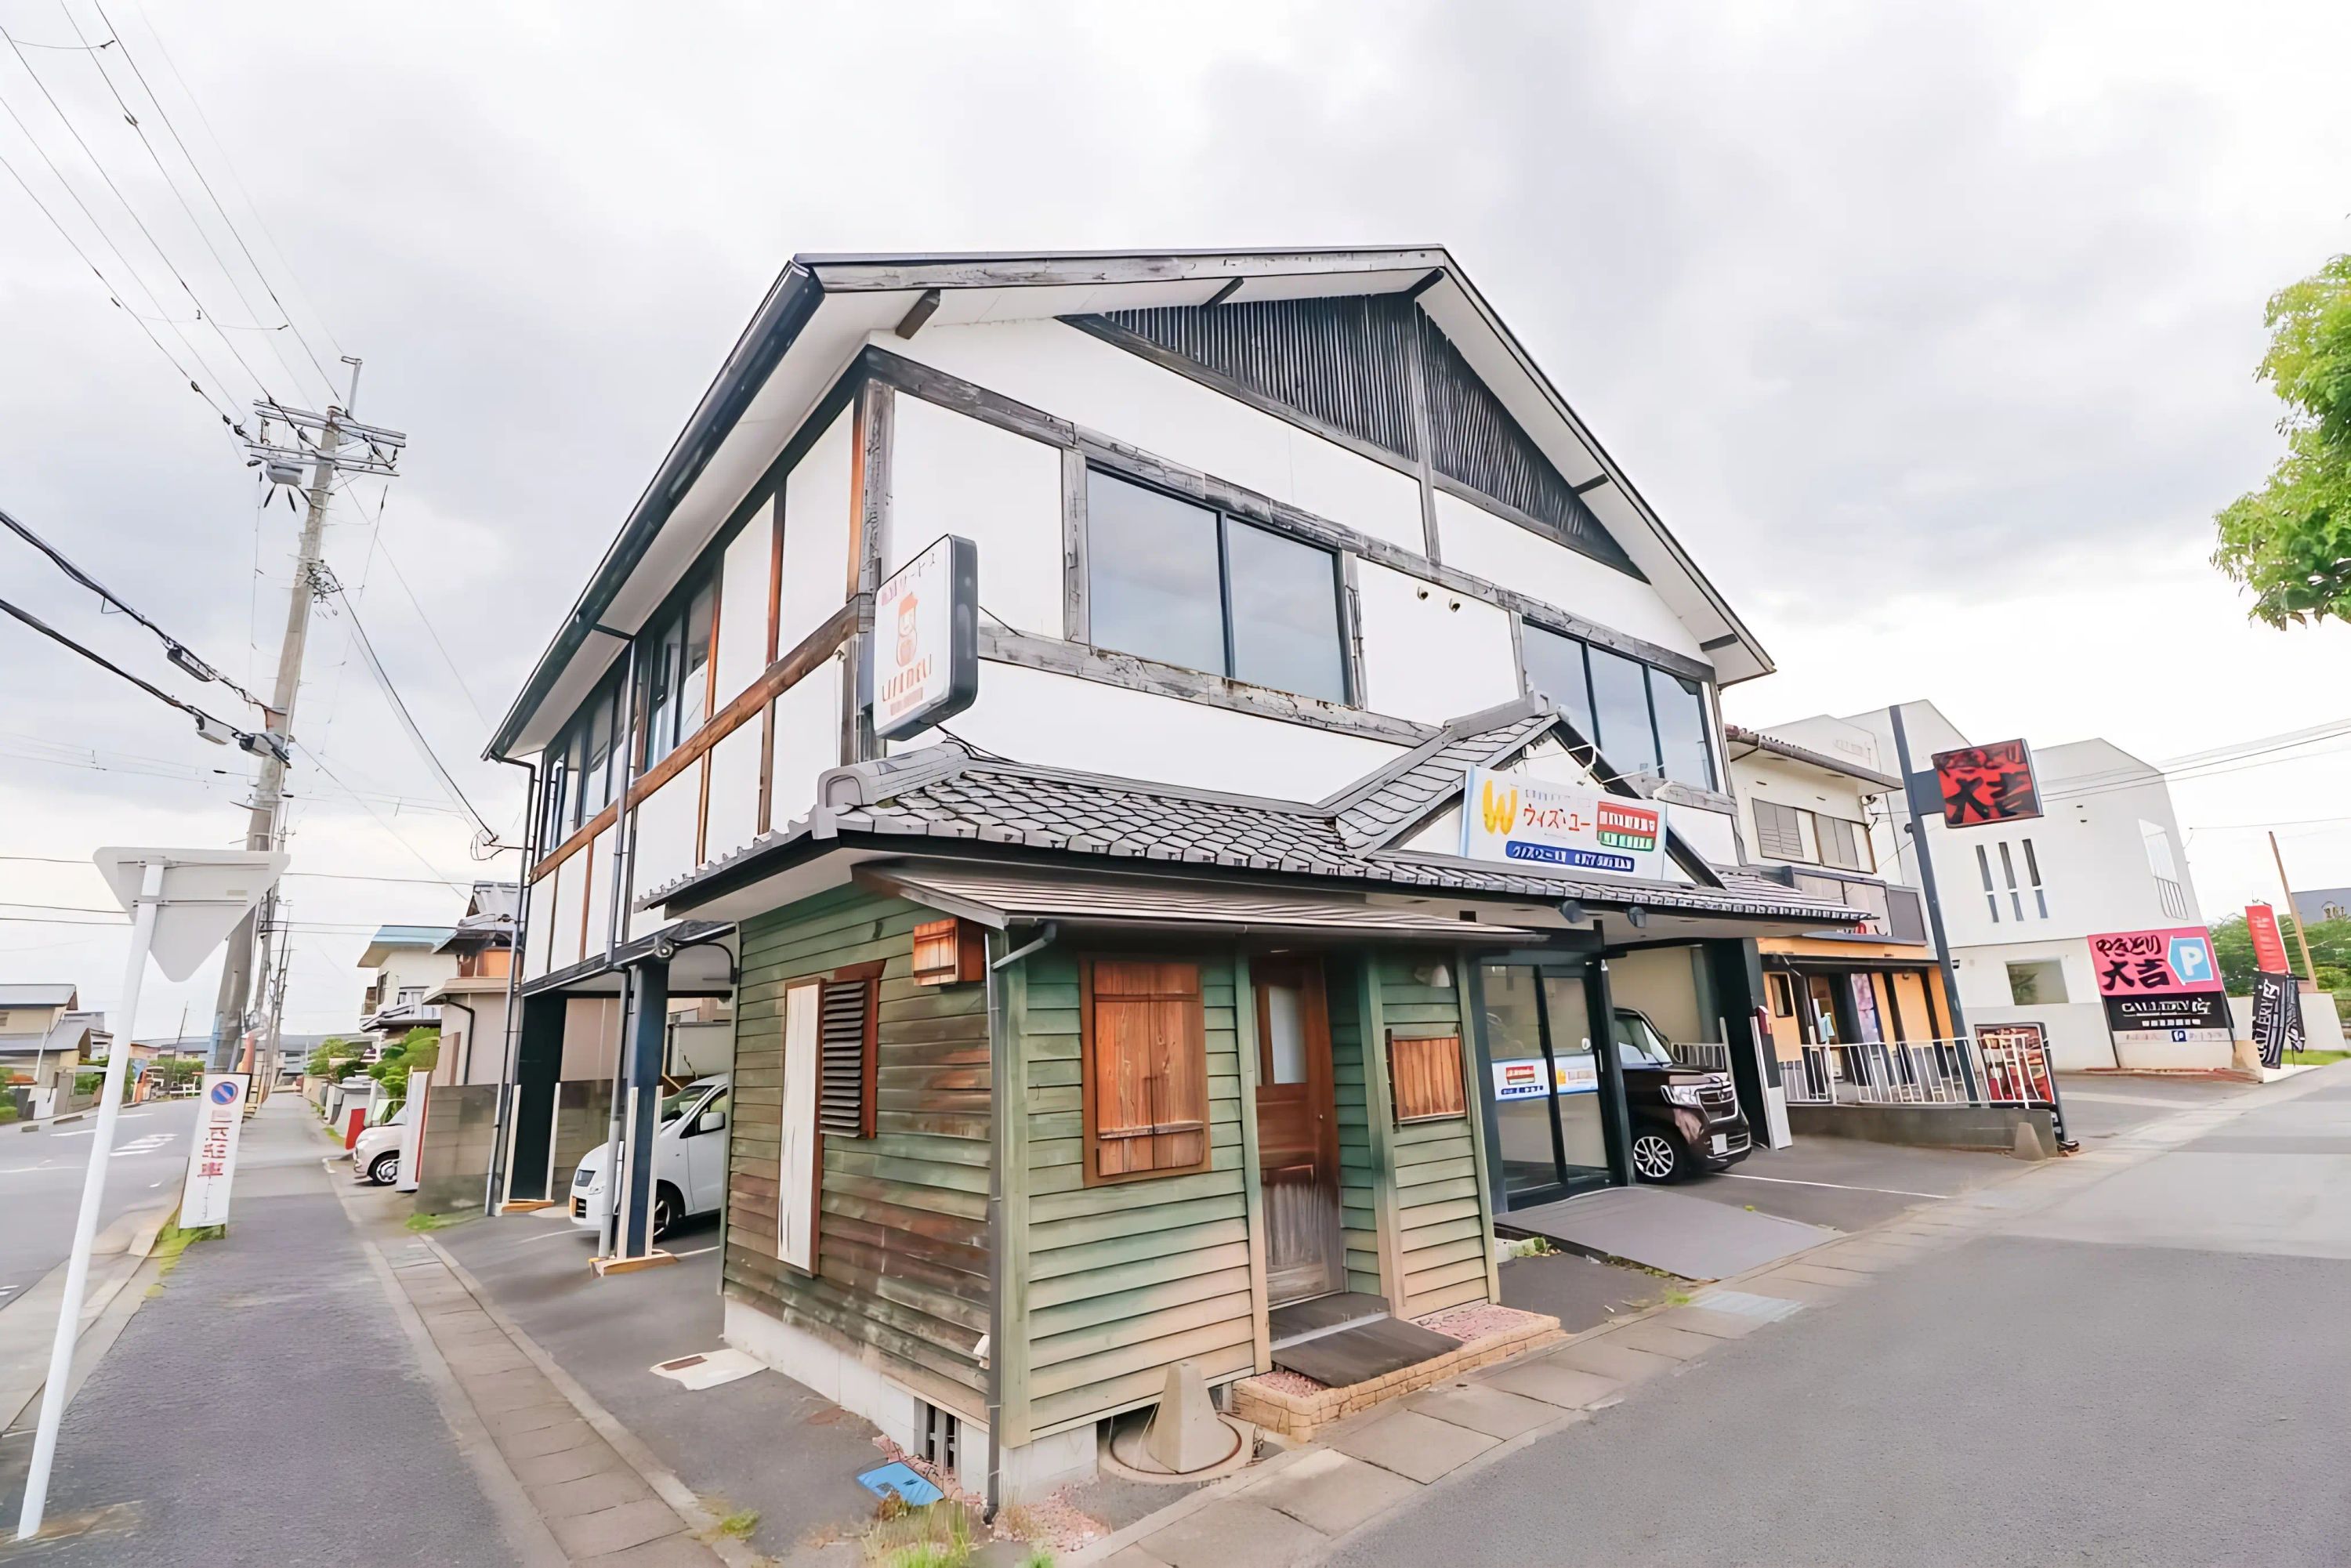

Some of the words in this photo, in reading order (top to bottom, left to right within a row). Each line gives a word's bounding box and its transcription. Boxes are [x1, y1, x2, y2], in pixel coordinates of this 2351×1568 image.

[1944, 770, 2038, 824] 大吉
[2102, 958, 2170, 991] 大吉
[2179, 946, 2204, 976] P
